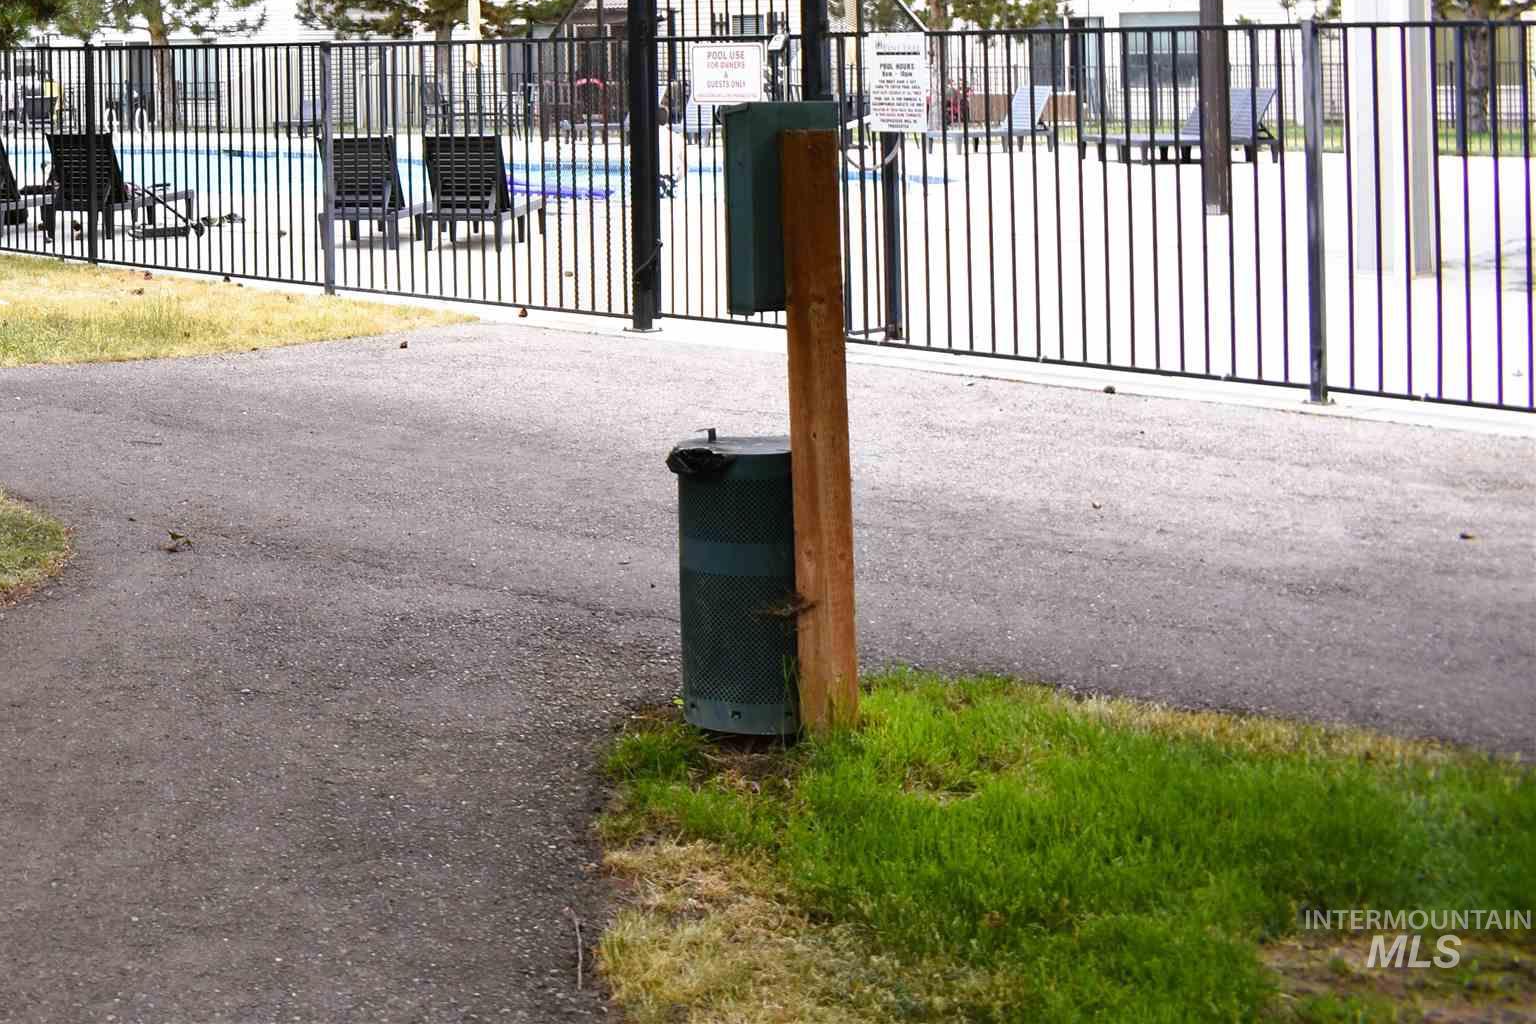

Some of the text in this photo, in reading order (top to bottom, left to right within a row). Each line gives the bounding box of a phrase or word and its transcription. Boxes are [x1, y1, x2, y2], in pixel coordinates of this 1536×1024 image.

[706, 50, 745, 60] POOL USE
[706, 80, 729, 88] GUESTS
